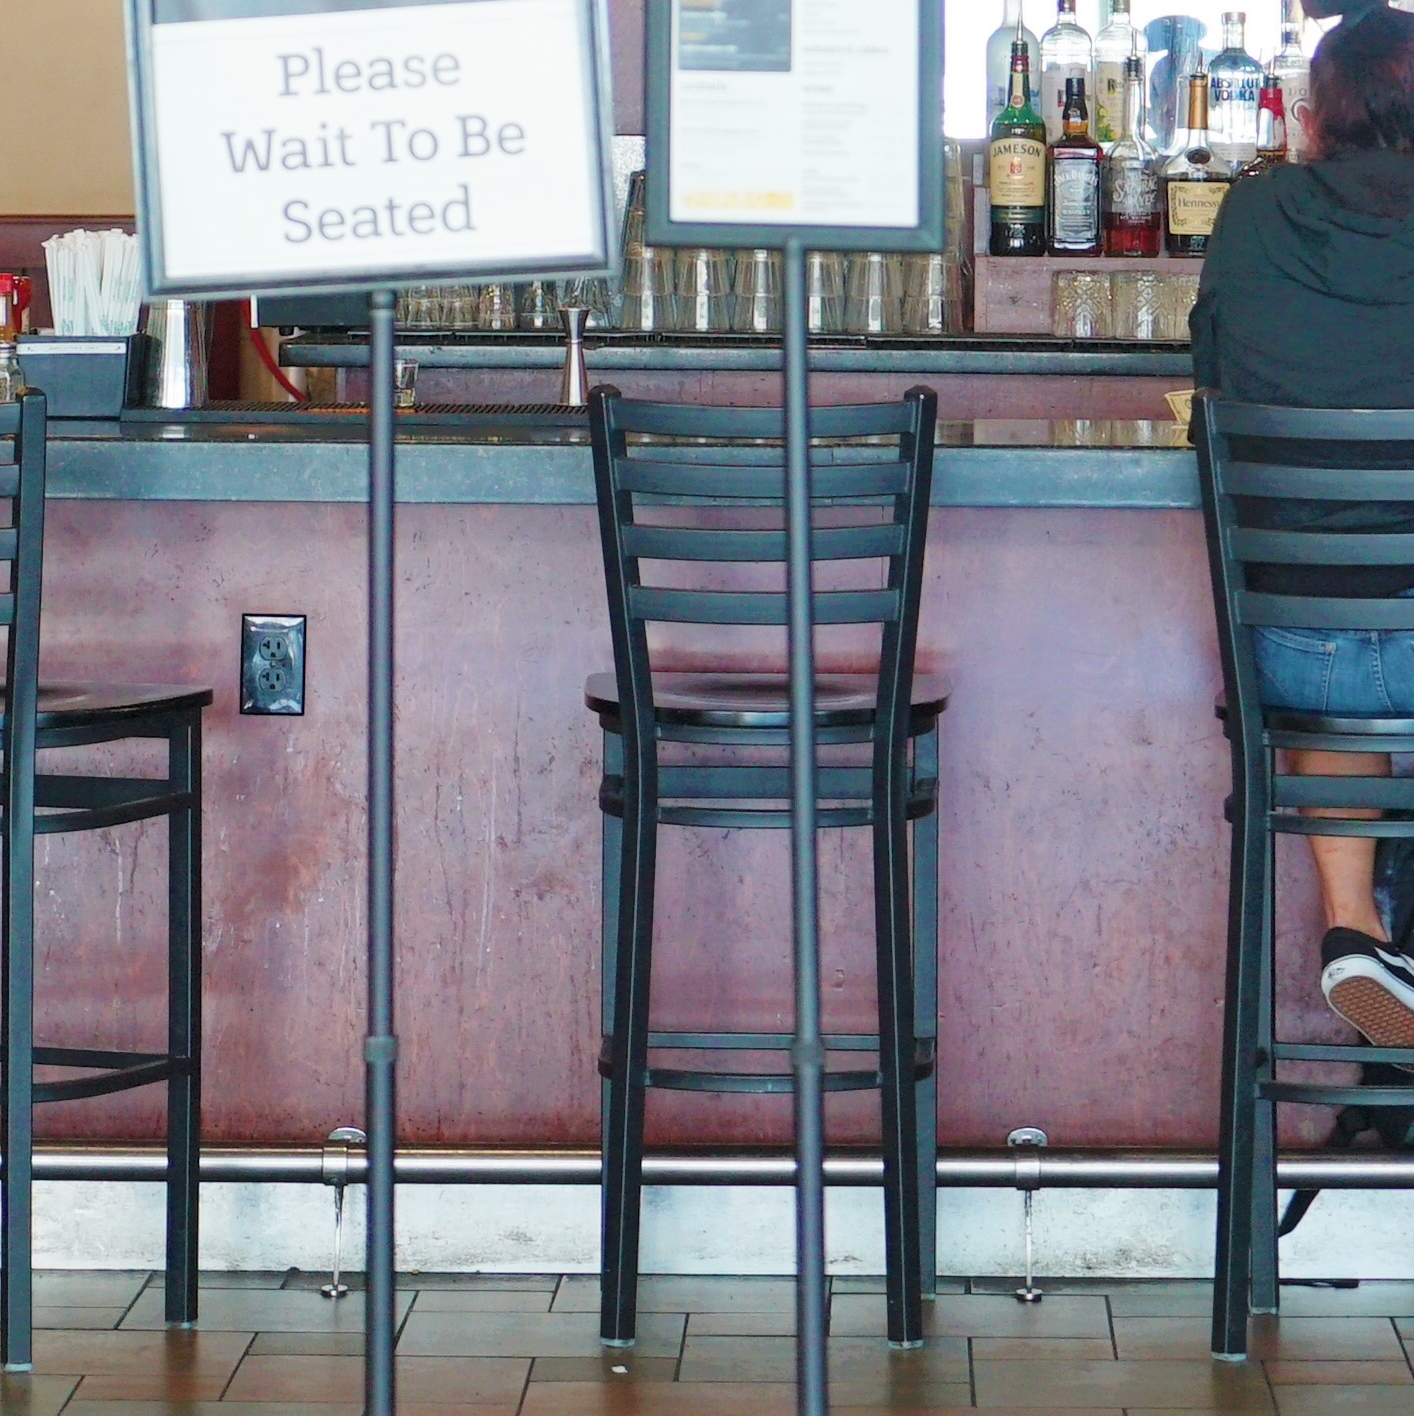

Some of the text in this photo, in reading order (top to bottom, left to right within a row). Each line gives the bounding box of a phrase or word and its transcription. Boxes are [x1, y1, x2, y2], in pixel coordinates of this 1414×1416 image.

[276, 46, 461, 97] Please
[221, 115, 526, 173] Wait To Be
[992, 143, 1042, 159] JAMESON
[283, 182, 477, 244] Seated
